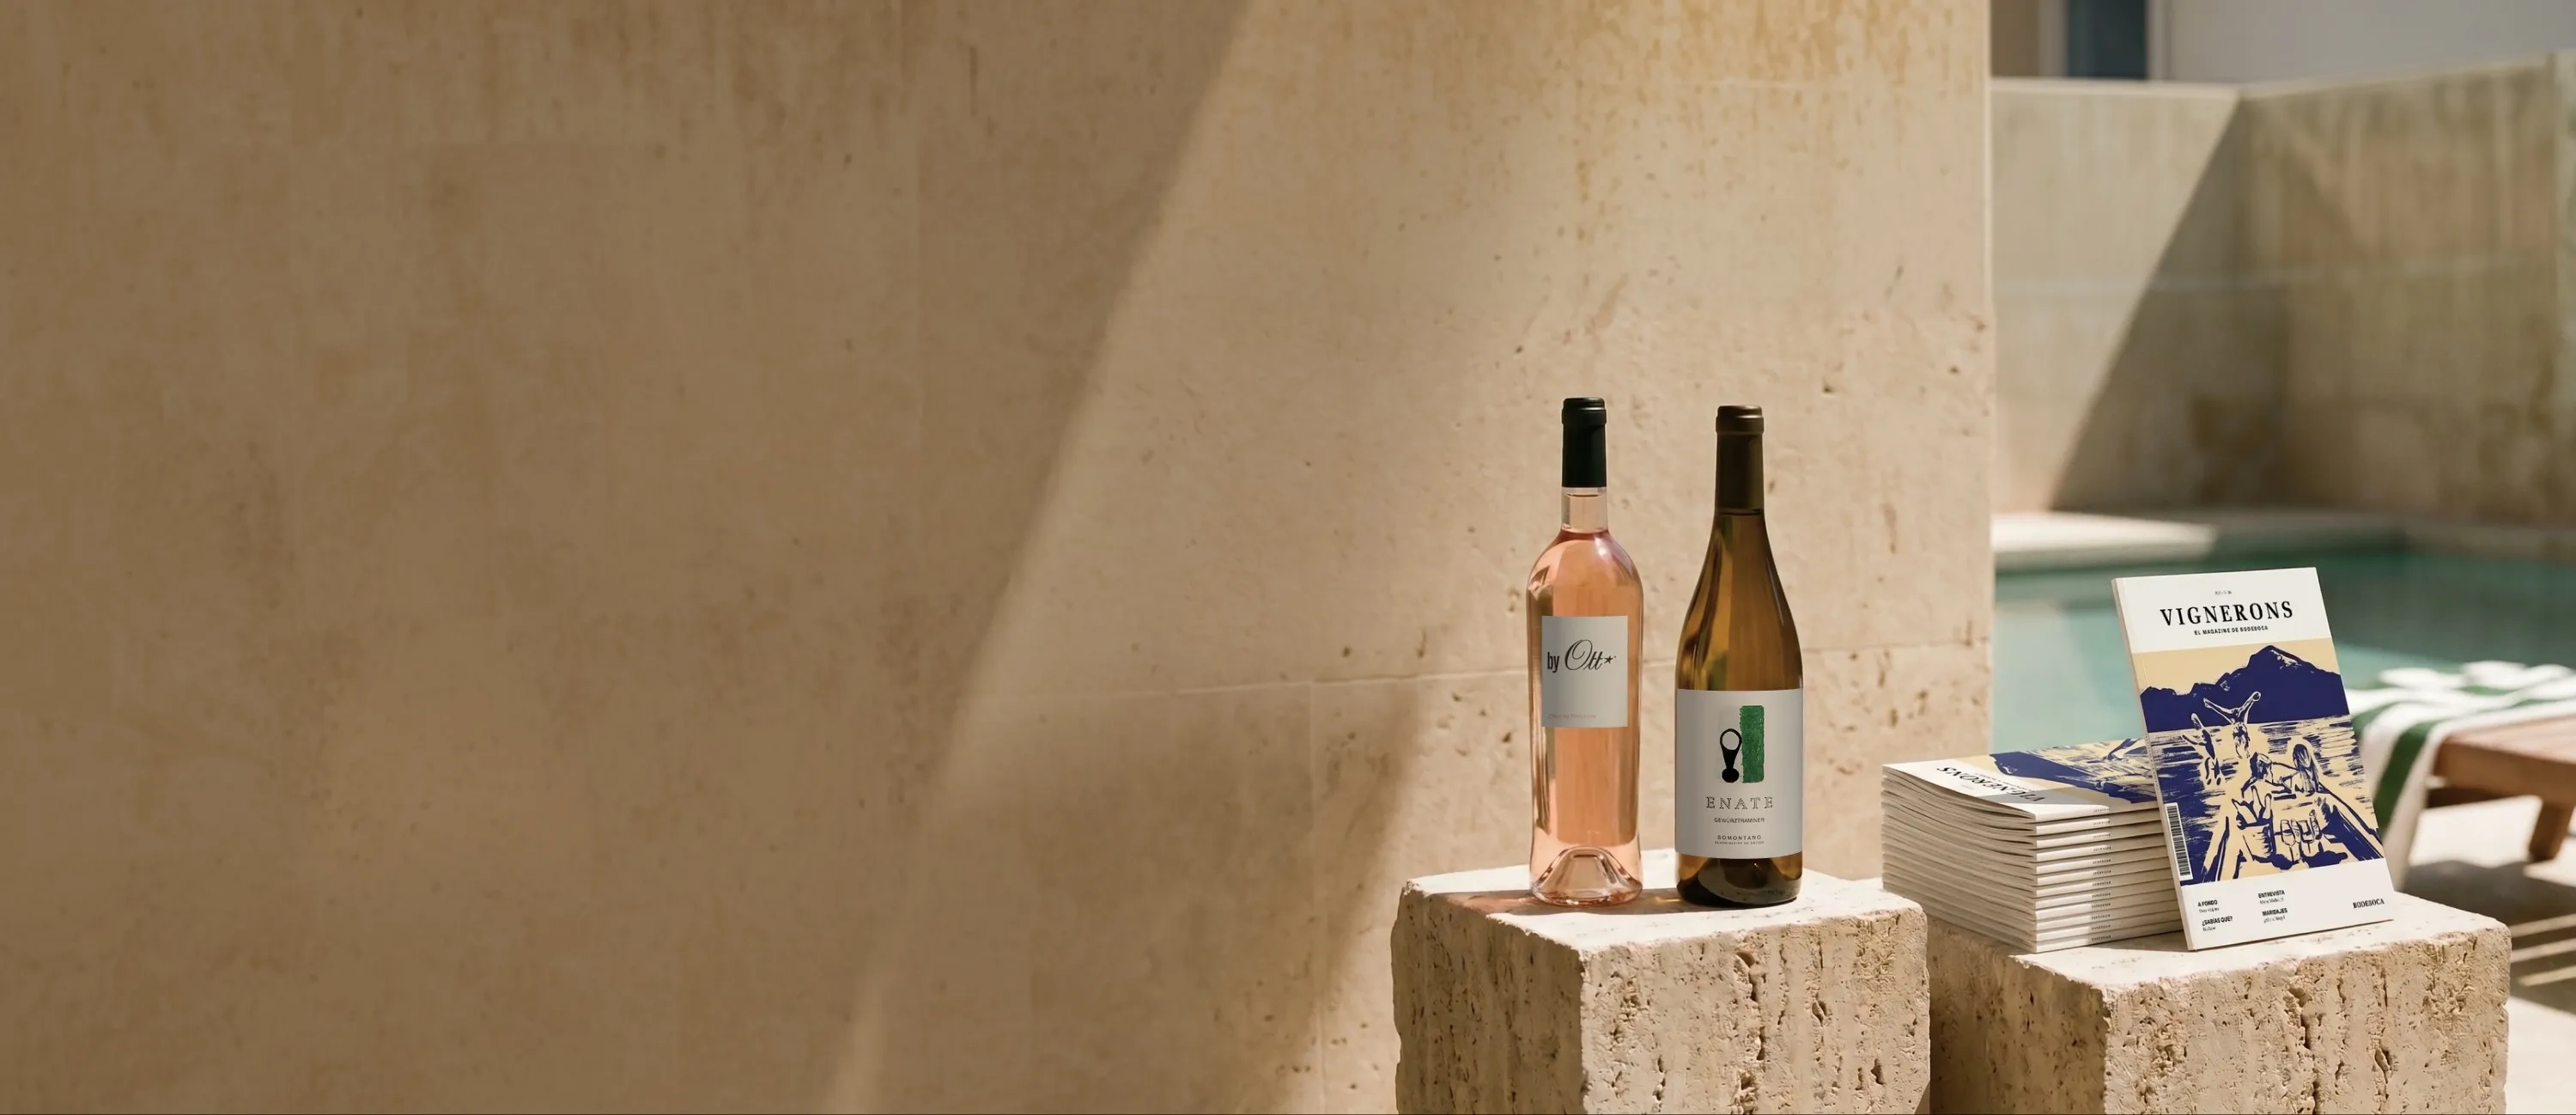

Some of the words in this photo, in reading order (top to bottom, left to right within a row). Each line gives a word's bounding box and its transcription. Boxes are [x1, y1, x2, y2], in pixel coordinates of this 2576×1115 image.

[2160, 600, 2293, 626] VIGNERONS
[1547, 651, 1560, 673] by
[1564, 639, 1603, 671] Ott
[1936, 767, 2045, 801] VIGNERONS
[1706, 796, 1773, 809] ENATE
[2353, 899, 2385, 908] BODEBOCA
